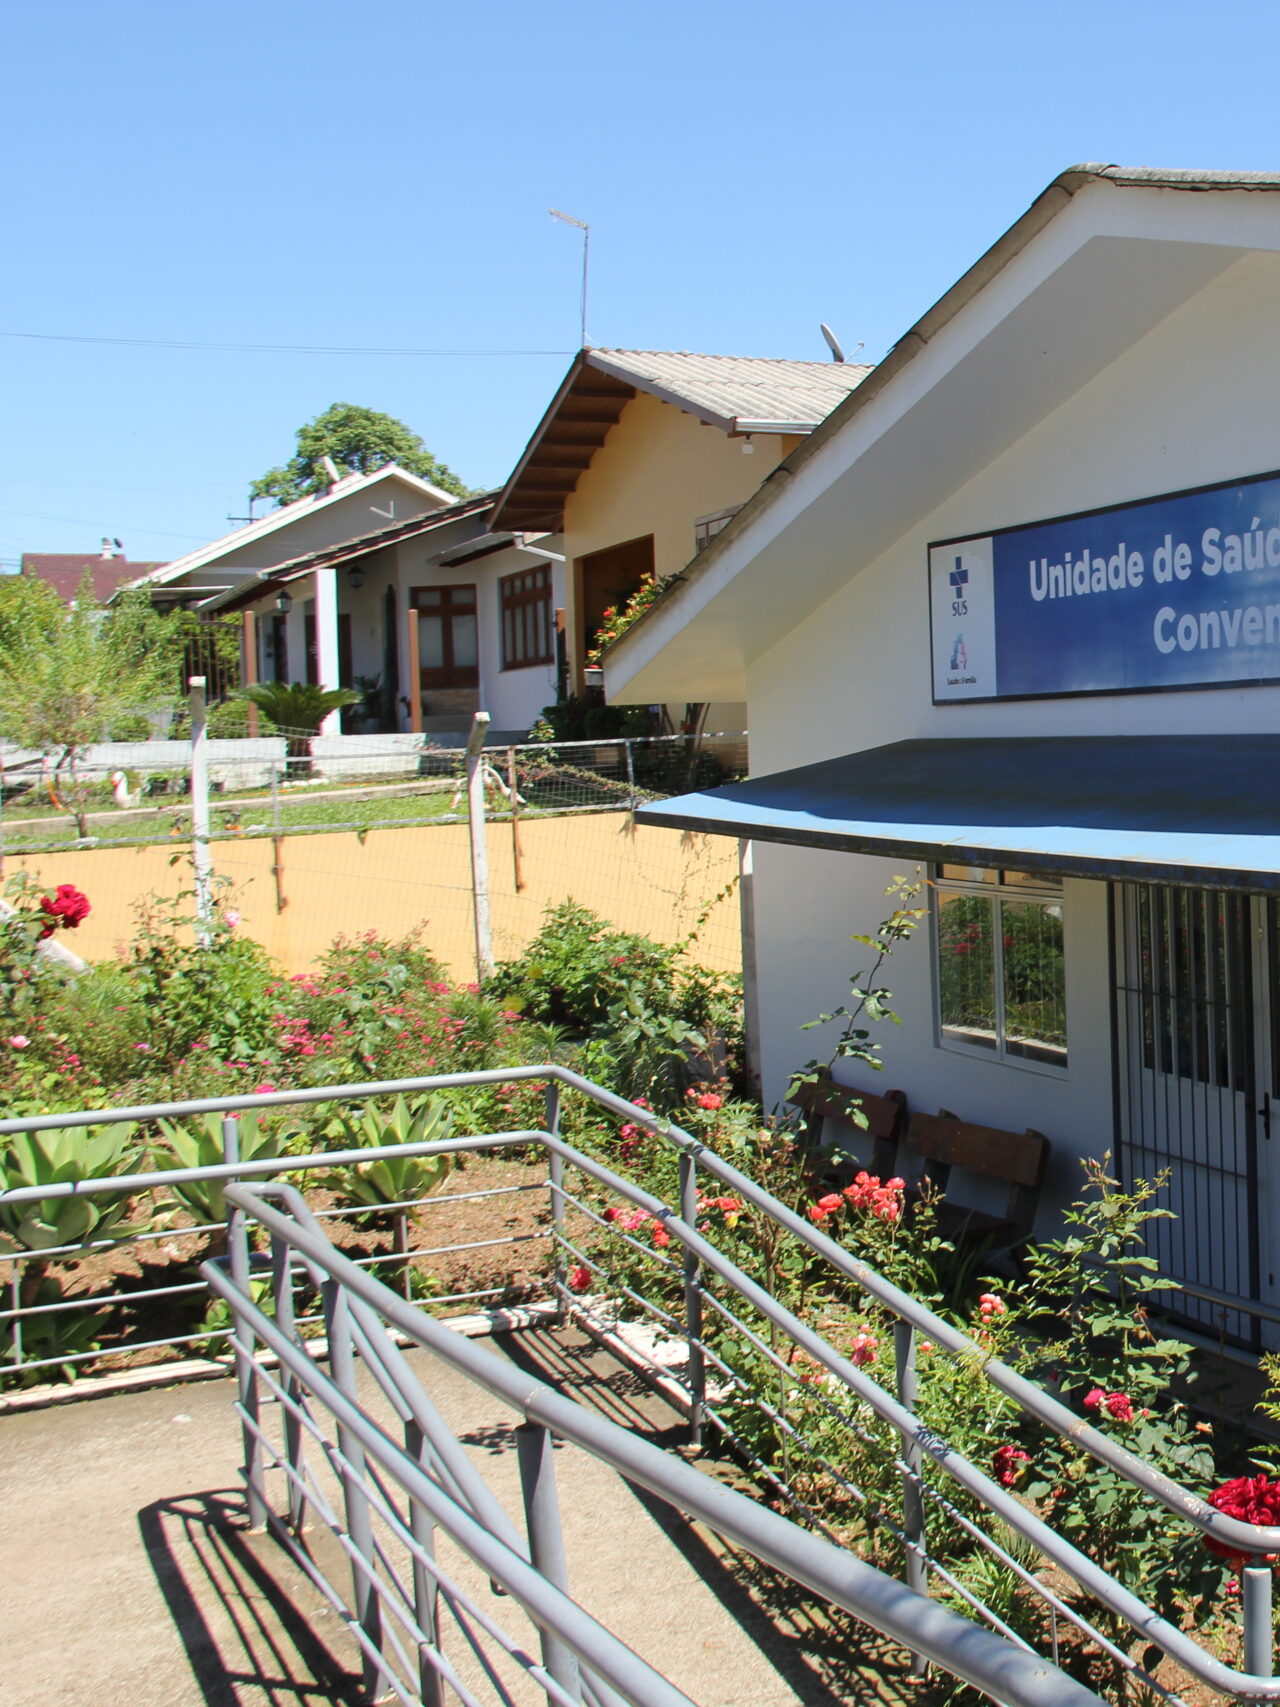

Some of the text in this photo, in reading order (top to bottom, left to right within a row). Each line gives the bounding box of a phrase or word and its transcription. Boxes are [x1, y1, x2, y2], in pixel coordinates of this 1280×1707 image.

[1029, 542, 1145, 602] Unidade
[1153, 534, 1193, 584] de
[952, 600, 968, 616] SUS
